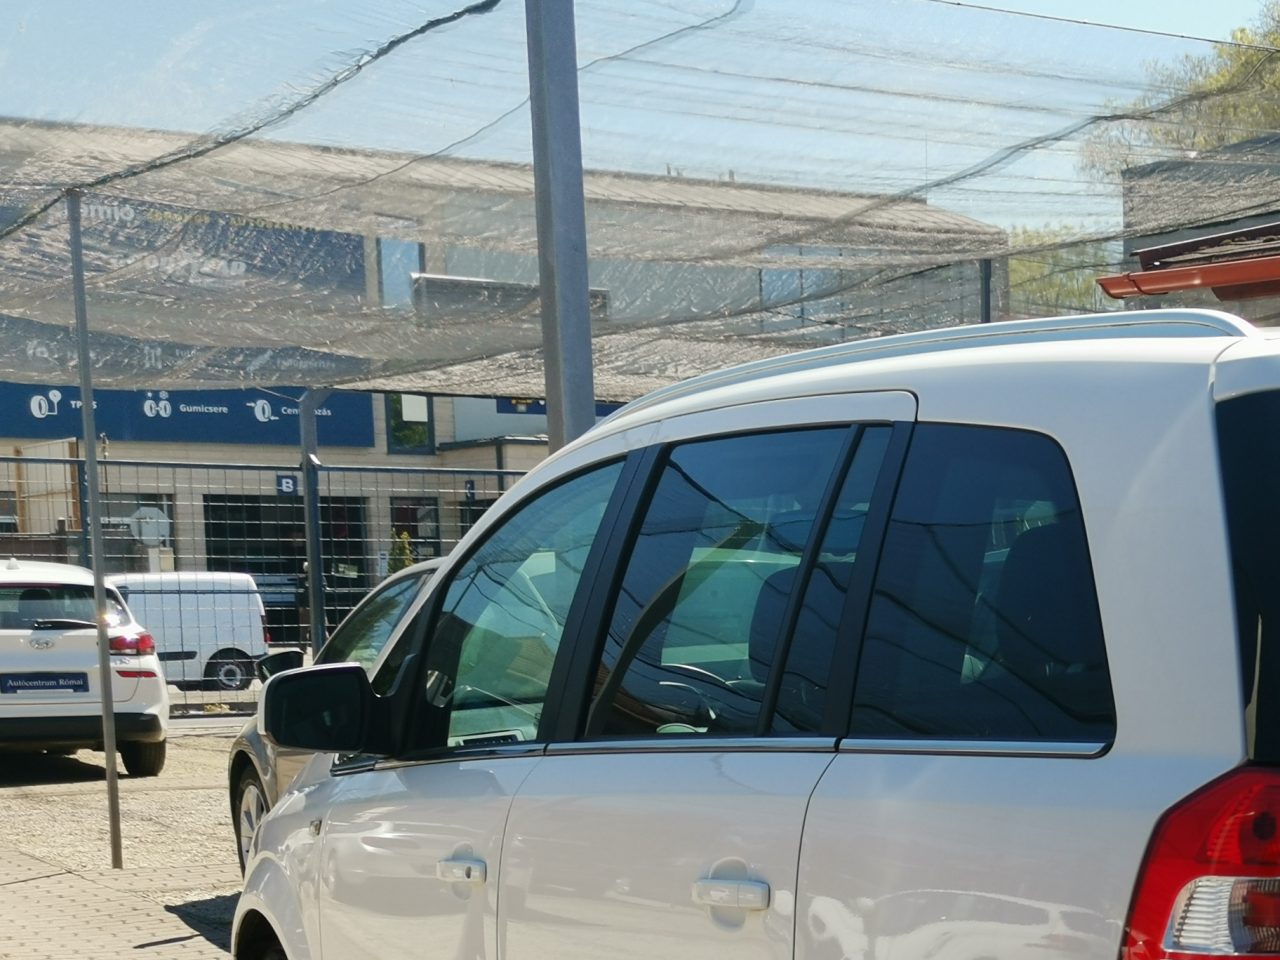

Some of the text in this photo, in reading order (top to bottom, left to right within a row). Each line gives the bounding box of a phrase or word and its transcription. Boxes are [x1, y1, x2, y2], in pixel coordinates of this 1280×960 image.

[70, 400, 97, 409] TPS
[179, 403, 229, 414] Gumicsere
[281, 479, 293, 492] B
